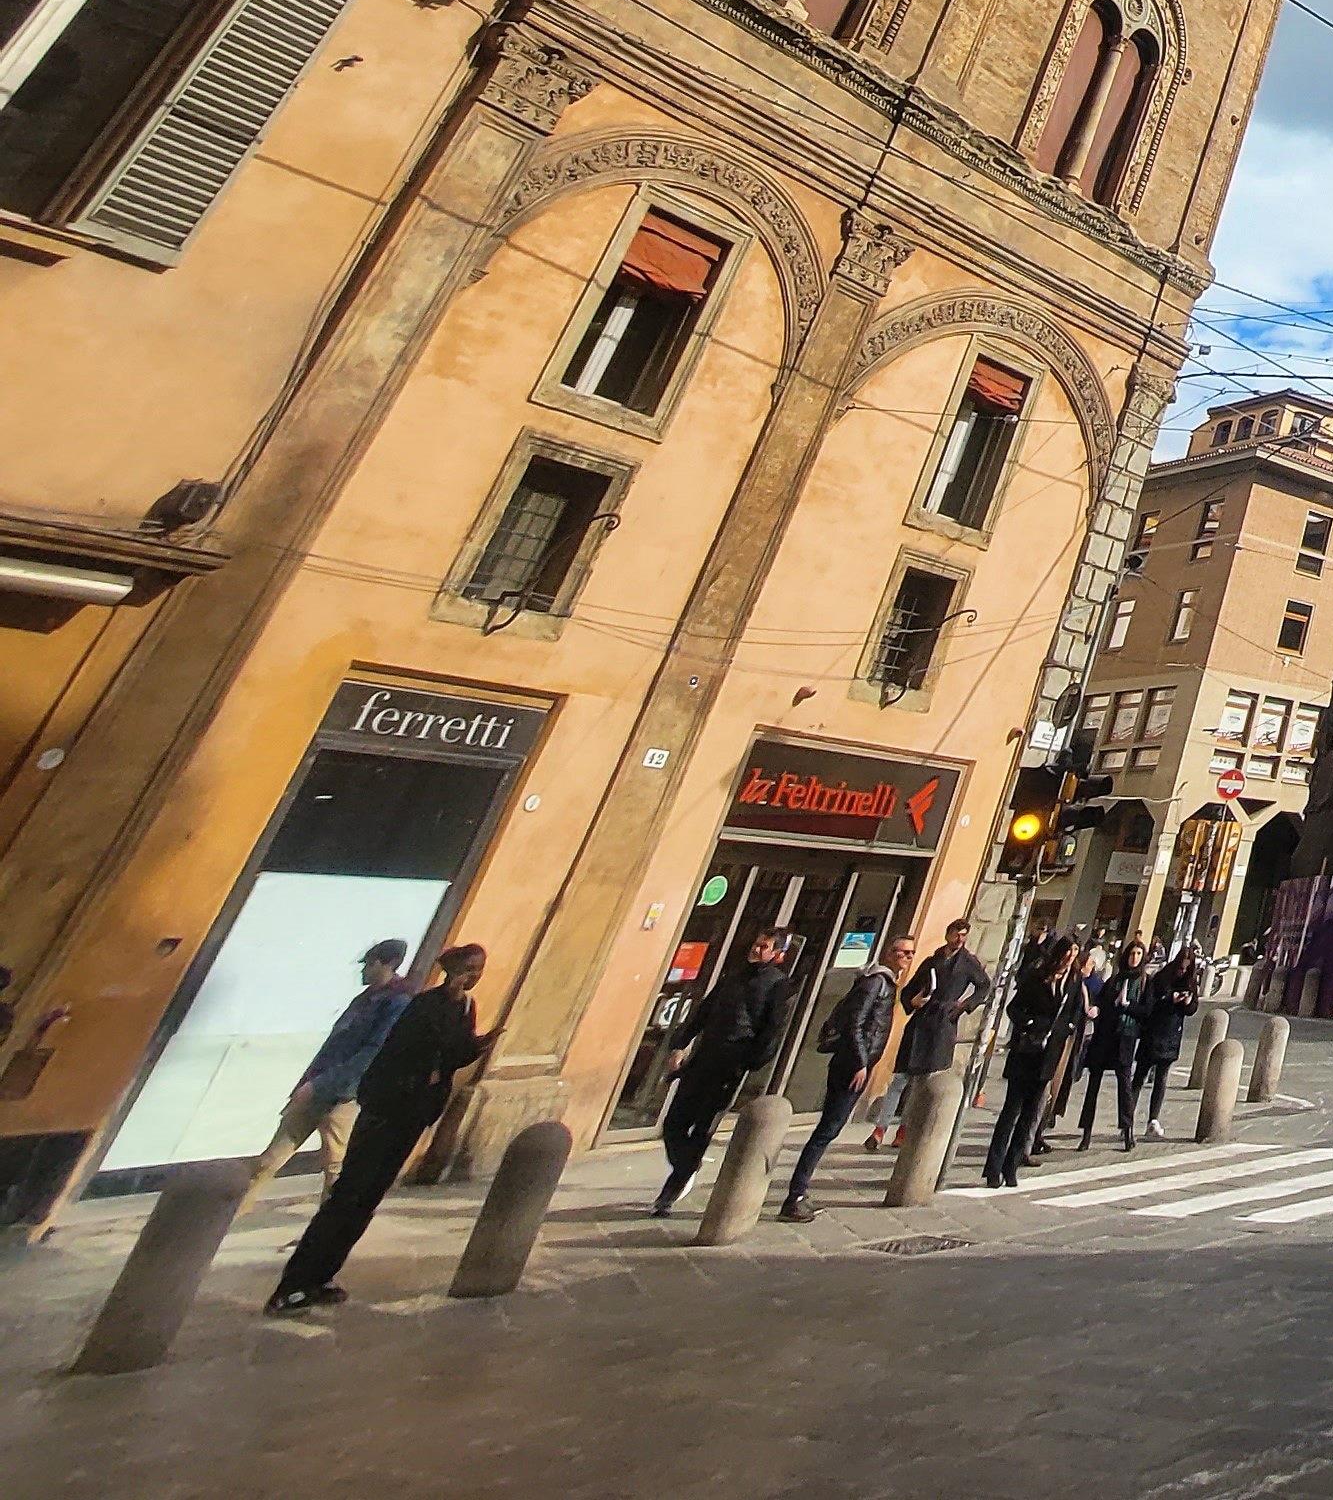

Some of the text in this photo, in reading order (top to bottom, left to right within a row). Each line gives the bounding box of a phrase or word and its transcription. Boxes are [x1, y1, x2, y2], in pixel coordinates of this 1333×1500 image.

[352, 690, 515, 749] ferretti
[739, 767, 901, 819] la Feltrinelli
